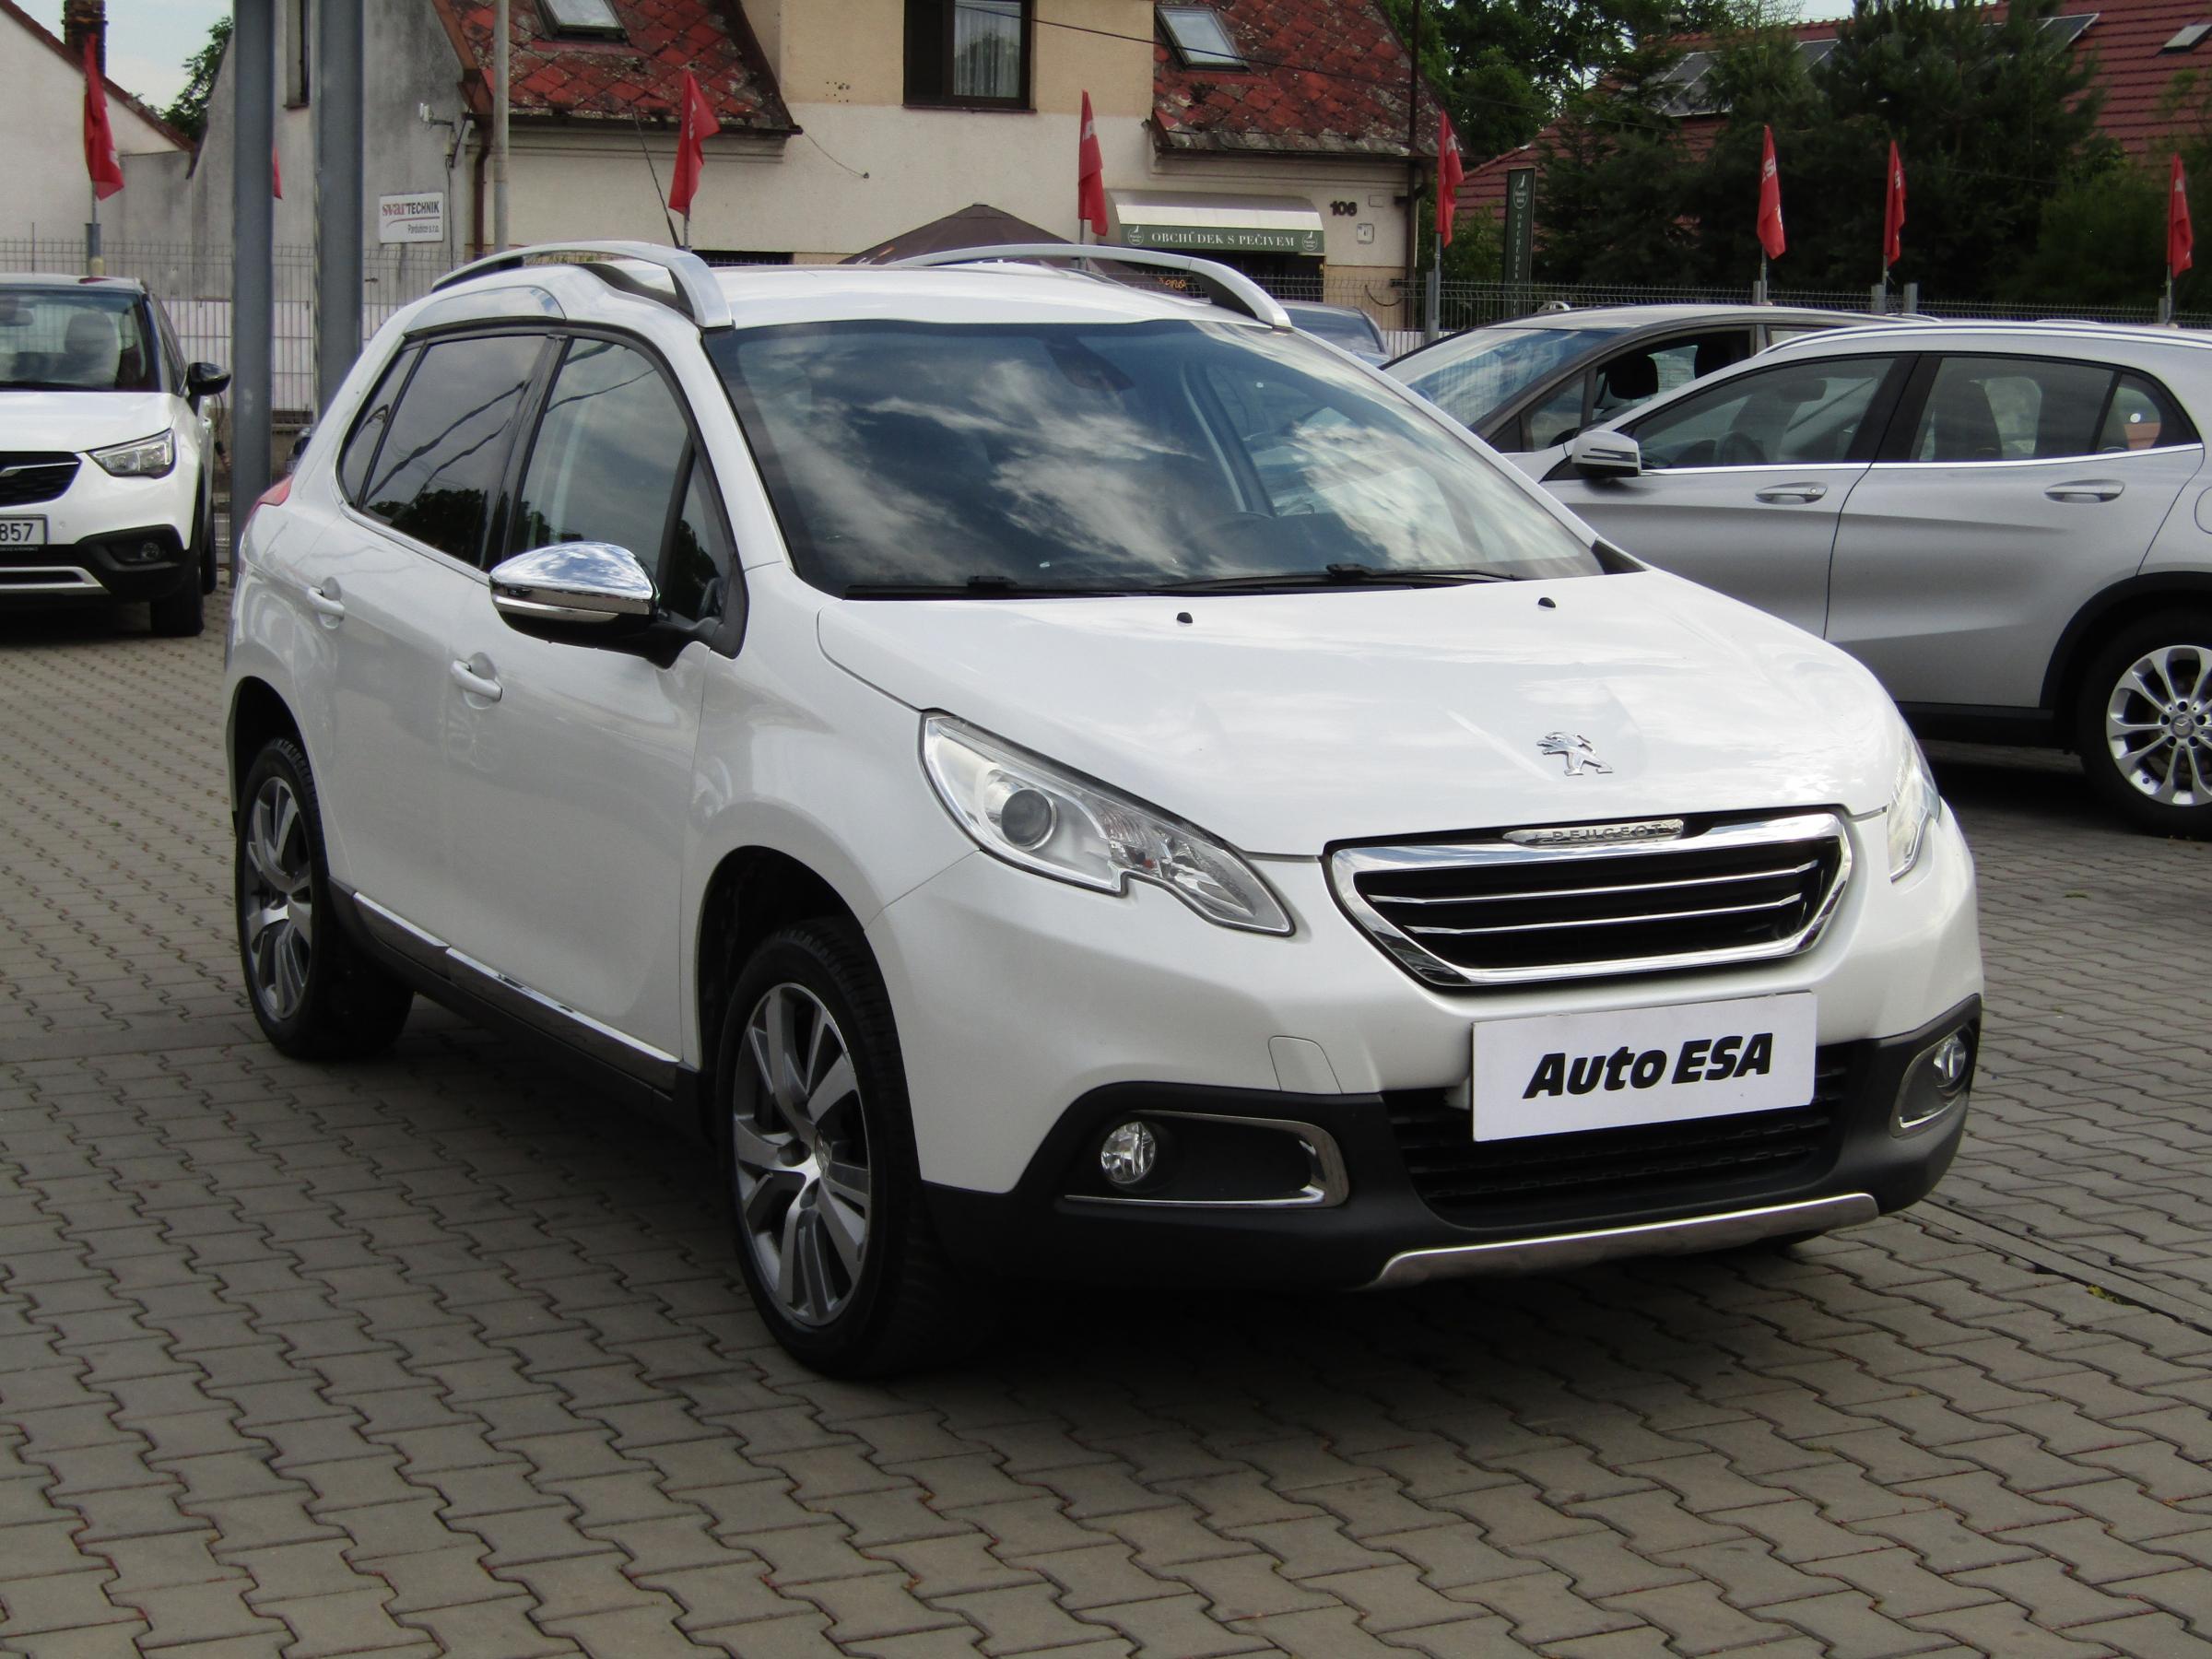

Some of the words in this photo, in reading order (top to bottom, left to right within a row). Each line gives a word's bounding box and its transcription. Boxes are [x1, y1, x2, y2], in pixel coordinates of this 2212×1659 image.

[1330, 201, 1358, 217] 106
[1151, 231, 1224, 245] OBCHŮDEK
[1228, 234, 1235, 245] S
[1239, 233, 1295, 247] PEČIVEM
[1552, 823, 1662, 841] PEUGEOT
[1522, 1046, 1667, 1100] Auto
[1671, 1032, 1773, 1085] ESA
